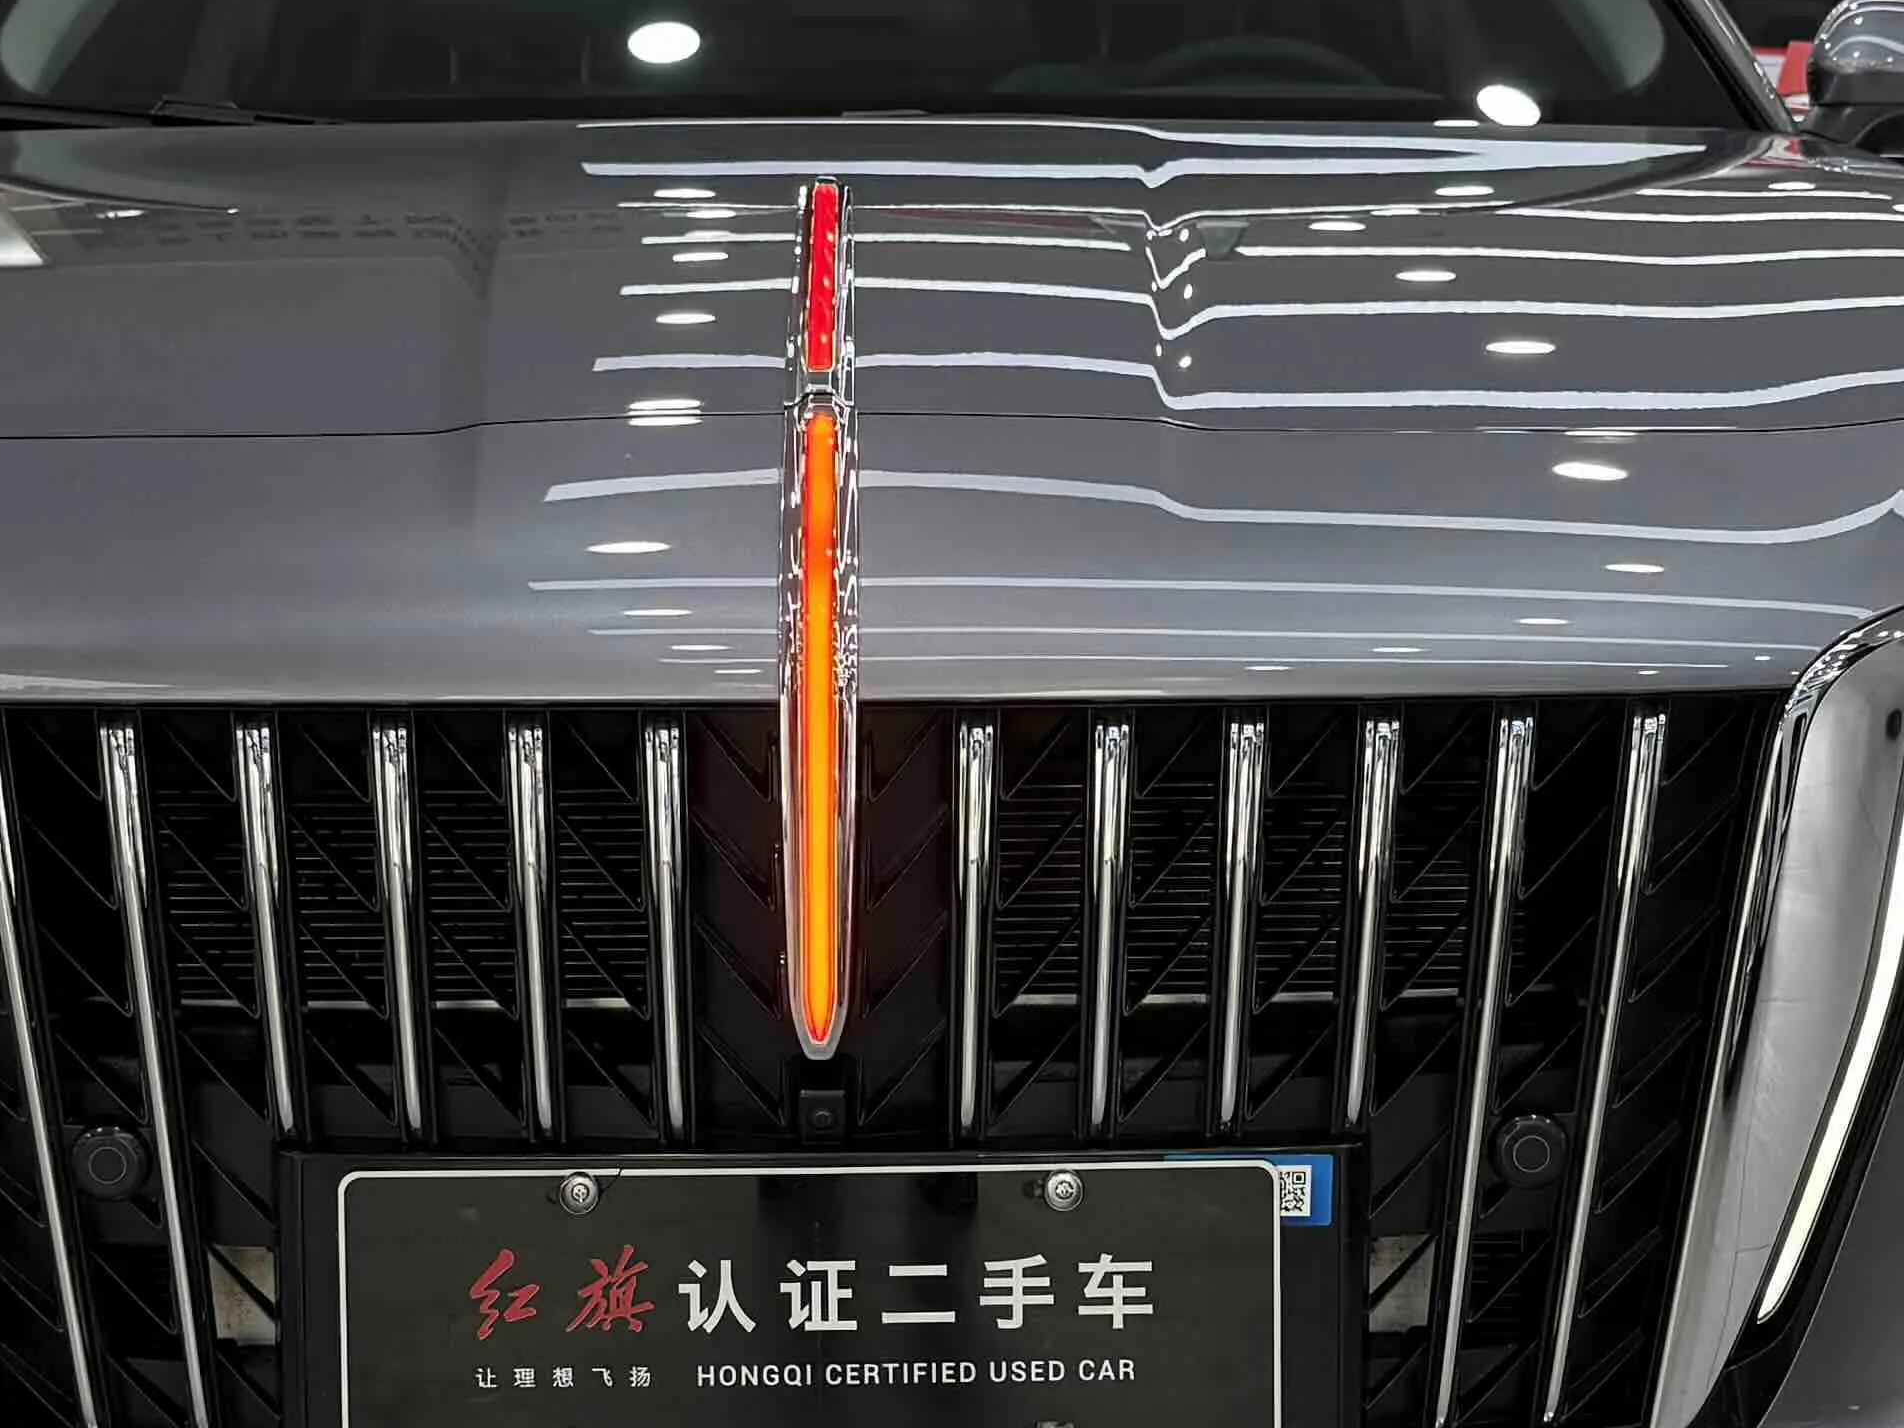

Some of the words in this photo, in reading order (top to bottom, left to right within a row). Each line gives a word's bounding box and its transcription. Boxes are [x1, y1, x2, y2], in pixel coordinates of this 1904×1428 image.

[475, 1366, 652, 1390] 让理想飞扬
[696, 1364, 814, 1388] HONGQI
[825, 1361, 977, 1386] CERTIFIED
[988, 1360, 1065, 1384] USED
[1077, 1358, 1137, 1382] CAR
